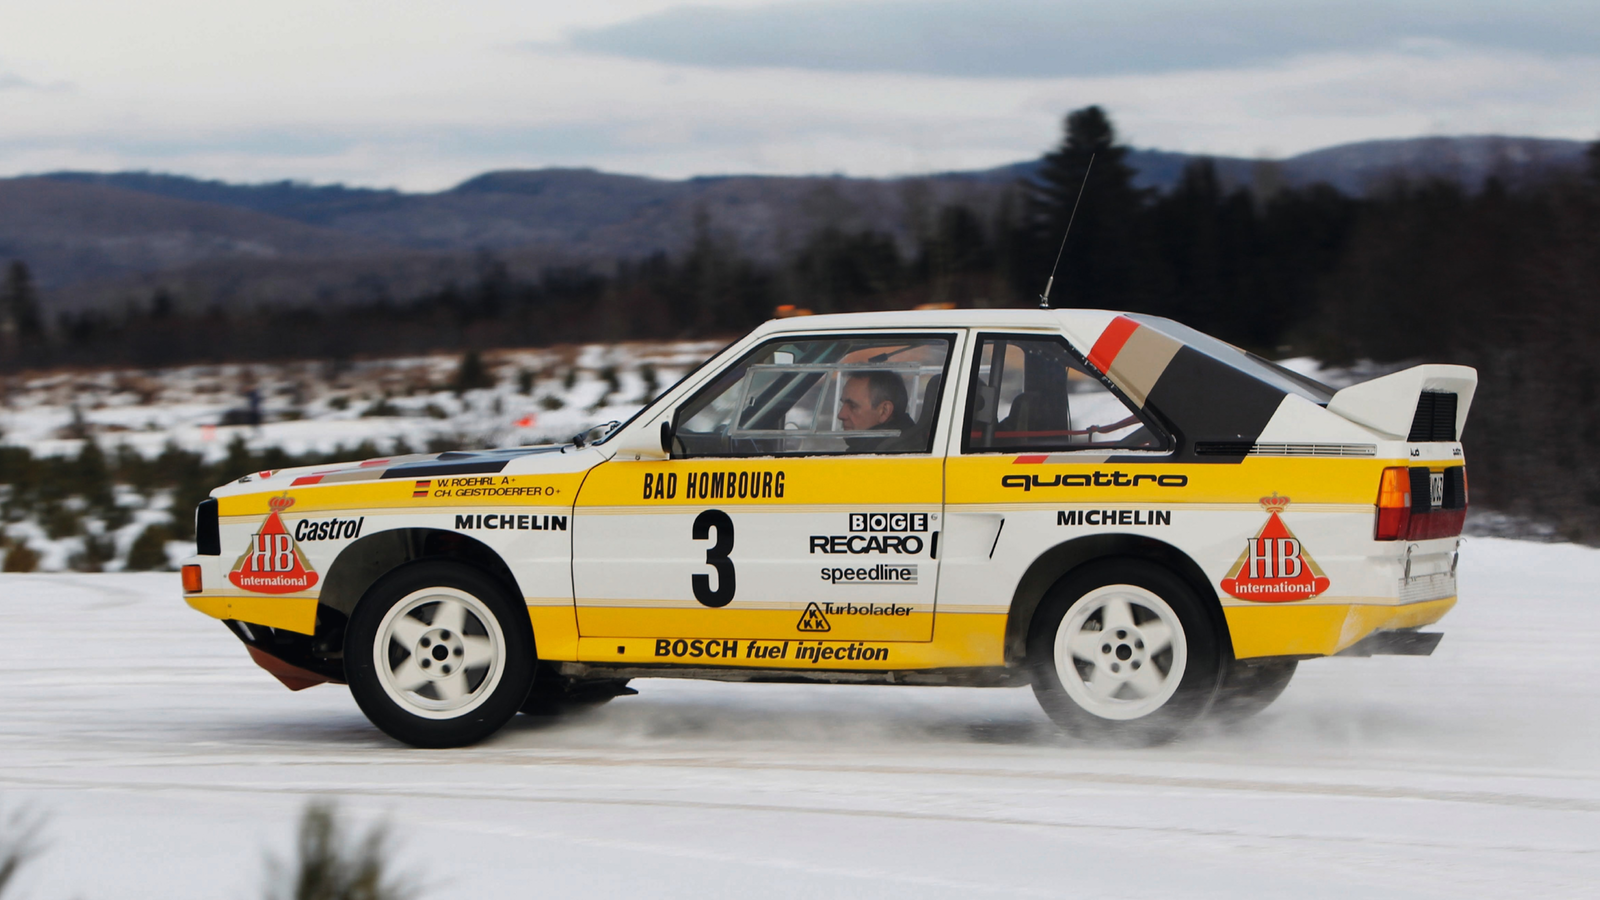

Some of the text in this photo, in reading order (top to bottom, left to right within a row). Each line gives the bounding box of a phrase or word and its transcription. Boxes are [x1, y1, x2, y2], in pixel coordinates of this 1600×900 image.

[437, 479, 449, 487] W.
[451, 477, 496, 487] ROEHRL
[643, 471, 786, 500] BAD HOMBOURG
[1001, 471, 1189, 492] quattro
[434, 489, 452, 498] CH.
[455, 487, 542, 497] GEISTDOERFER
[455, 514, 568, 531] MICHELIN
[850, 514, 927, 532] BOGE
[1056, 510, 1172, 527] MICHELIN
[295, 516, 364, 542] Castrol
[251, 533, 295, 572] HB
[809, 535, 924, 555] RECARO
[691, 508, 736, 608] 3
[1247, 537, 1303, 579] HB
[240, 575, 307, 586] international
[820, 564, 912, 584] speedline
[1235, 580, 1316, 594] international
[822, 602, 914, 616] Turbolader
[654, 639, 889, 663] BOSCH fuel injection
